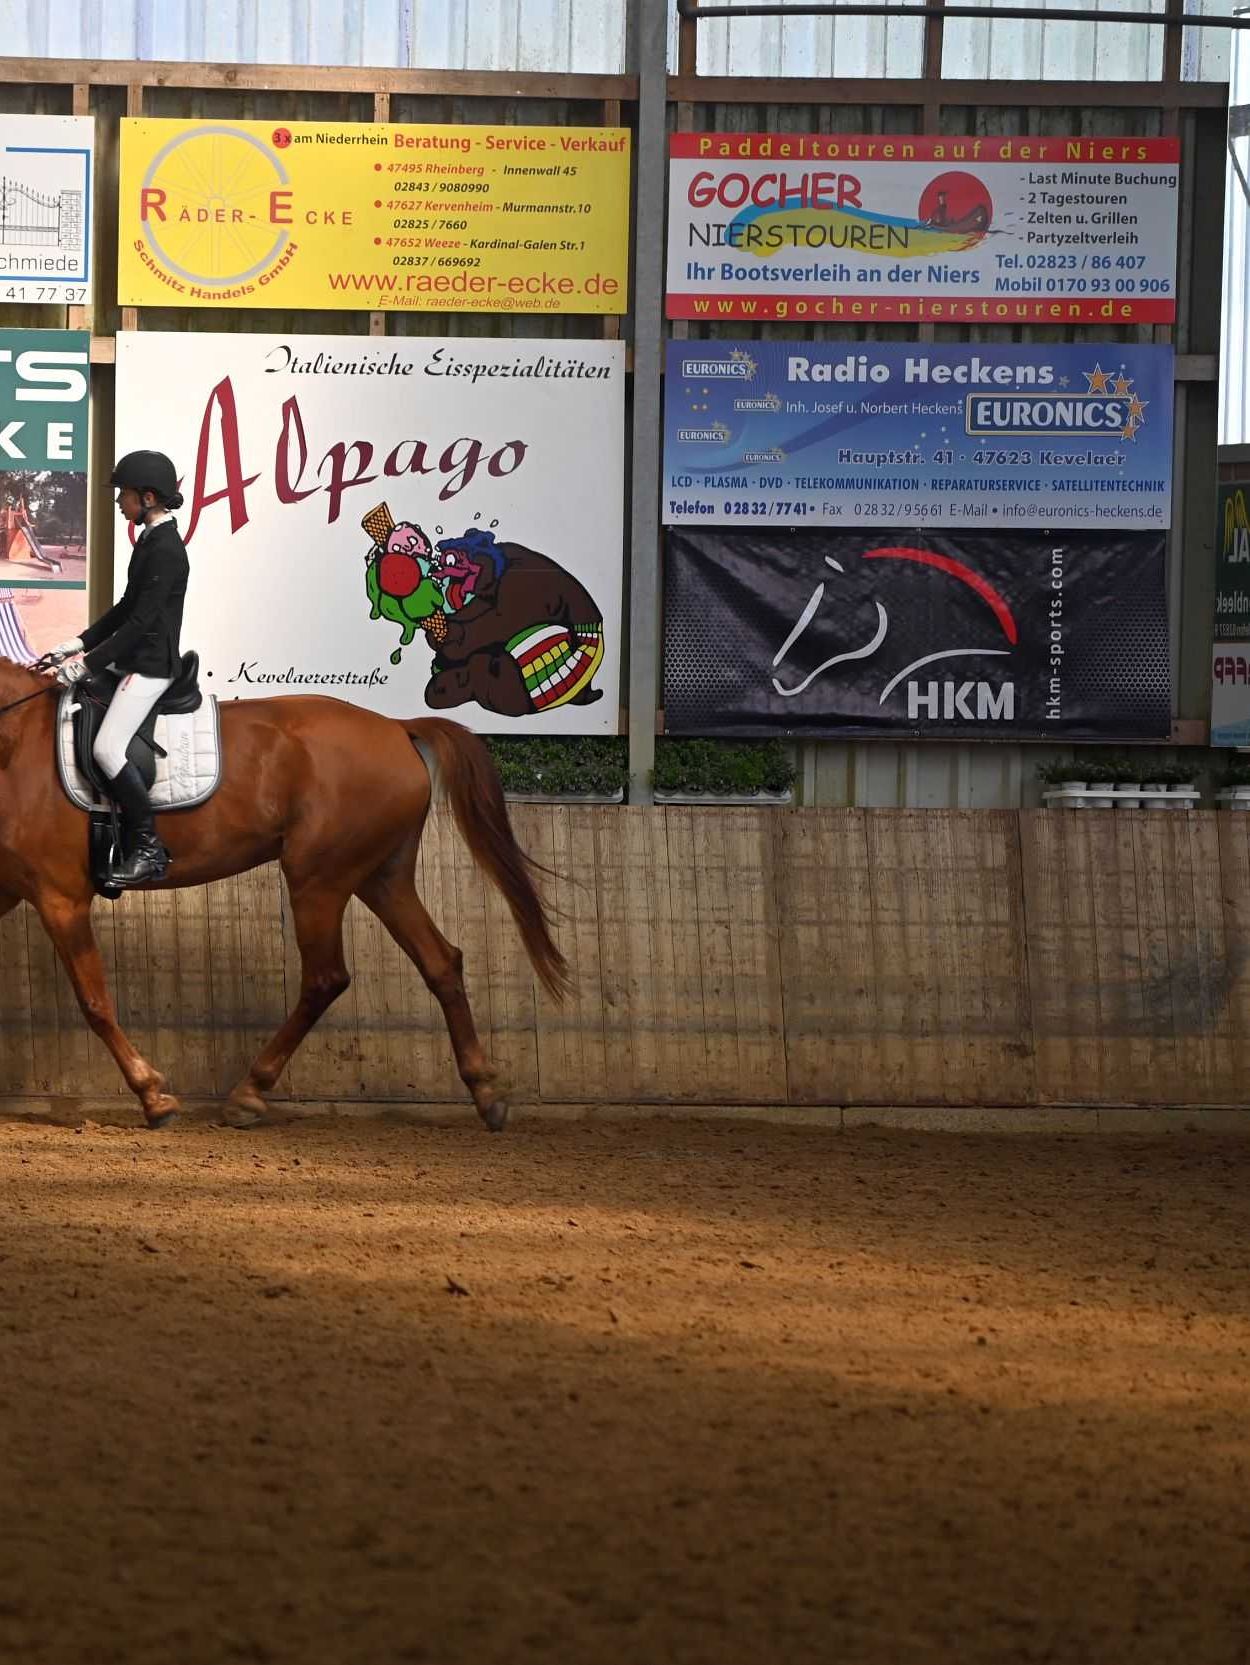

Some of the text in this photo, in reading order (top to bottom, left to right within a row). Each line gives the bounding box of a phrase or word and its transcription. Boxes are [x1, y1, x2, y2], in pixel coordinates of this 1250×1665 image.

[294, 136, 312, 144] am
[316, 134, 387, 145] Niederrhein
[394, 134, 470, 152] Beratung
[486, 136, 546, 150] Service
[561, 137, 626, 152] Verkauf
[700, 138, 1147, 160] Paddeltouren auf der Niers
[387, 164, 423, 173] 47495
[426, 164, 484, 176] Rheinberg
[504, 166, 560, 175] Innenwall
[563, 166, 577, 175] 45
[1029, 173, 1057, 185] Last
[1061, 173, 1110, 185] Minute
[1115, 173, 1176, 188] Buchung
[688, 172, 862, 209] GOCHER
[387, 201, 422, 210] 47627
[425, 201, 493, 211] Kervenheim
[1028, 193, 1036, 203] 2
[1040, 193, 1127, 207] Tagestouren
[1028, 212, 1071, 224] Zelten
[1076, 215, 1088, 224] u.
[1092, 212, 1138, 225] Grillen
[386, 238, 421, 248] 47652
[424, 239, 460, 248] Weeze
[470, 239, 557, 250] Kardinal-Galen
[689, 223, 909, 249] NIERSTOUREN
[1028, 232, 1138, 245] Partyzeltverleih
[134, 239, 298, 300] Schmitz Handels GmbH
[996, 254, 1023, 269] Tel.
[1027, 255, 1076, 269] 02823
[1092, 256, 1111, 269] 86
[1116, 256, 1145, 269] 407
[687, 263, 980, 283] Ihr Bootsverleih an der Niers
[329, 271, 619, 295] www.raeder-ecke.de
[995, 278, 1170, 292] Mobil 0170 93 00 906
[6, 287, 25, 300] 41
[37, 288, 56, 300] 77
[66, 288, 86, 301] 37
[380, 295, 560, 309] E-Mail: raeder-ecke@web.de
[693, 297, 1133, 319] www.gocher-nierstouren.de
[265, 345, 611, 383] Italienische Eisspezialitäten
[686, 363, 746, 375] EURONICS
[788, 356, 1054, 385] Radio Heckens
[736, 401, 775, 409] EURONICS
[786, 402, 963, 415] Inh. Josef u. Norbert Heckens
[977, 401, 1122, 427] EURONICS
[680, 431, 724, 441] EURONICS
[128, 375, 528, 546] Alpago
[838, 449, 1126, 467] Hauptstr. 41 47623 Kevelaer
[672, 476, 1164, 492] LCD PLASMA DVD TELEKOMMUNIKATION REPARATURSERVICE SATELLITENTECHNIK
[670, 501, 714, 514] Telefon
[823, 504, 842, 516] Fax
[950, 504, 987, 516] E-Mail
[1003, 504, 1162, 518] info@euronics-heckens.de
[1045, 548, 1063, 720] hkm-sports.com
[228, 662, 389, 688] Kevelaererstraße
[908, 681, 1014, 720] HKM
